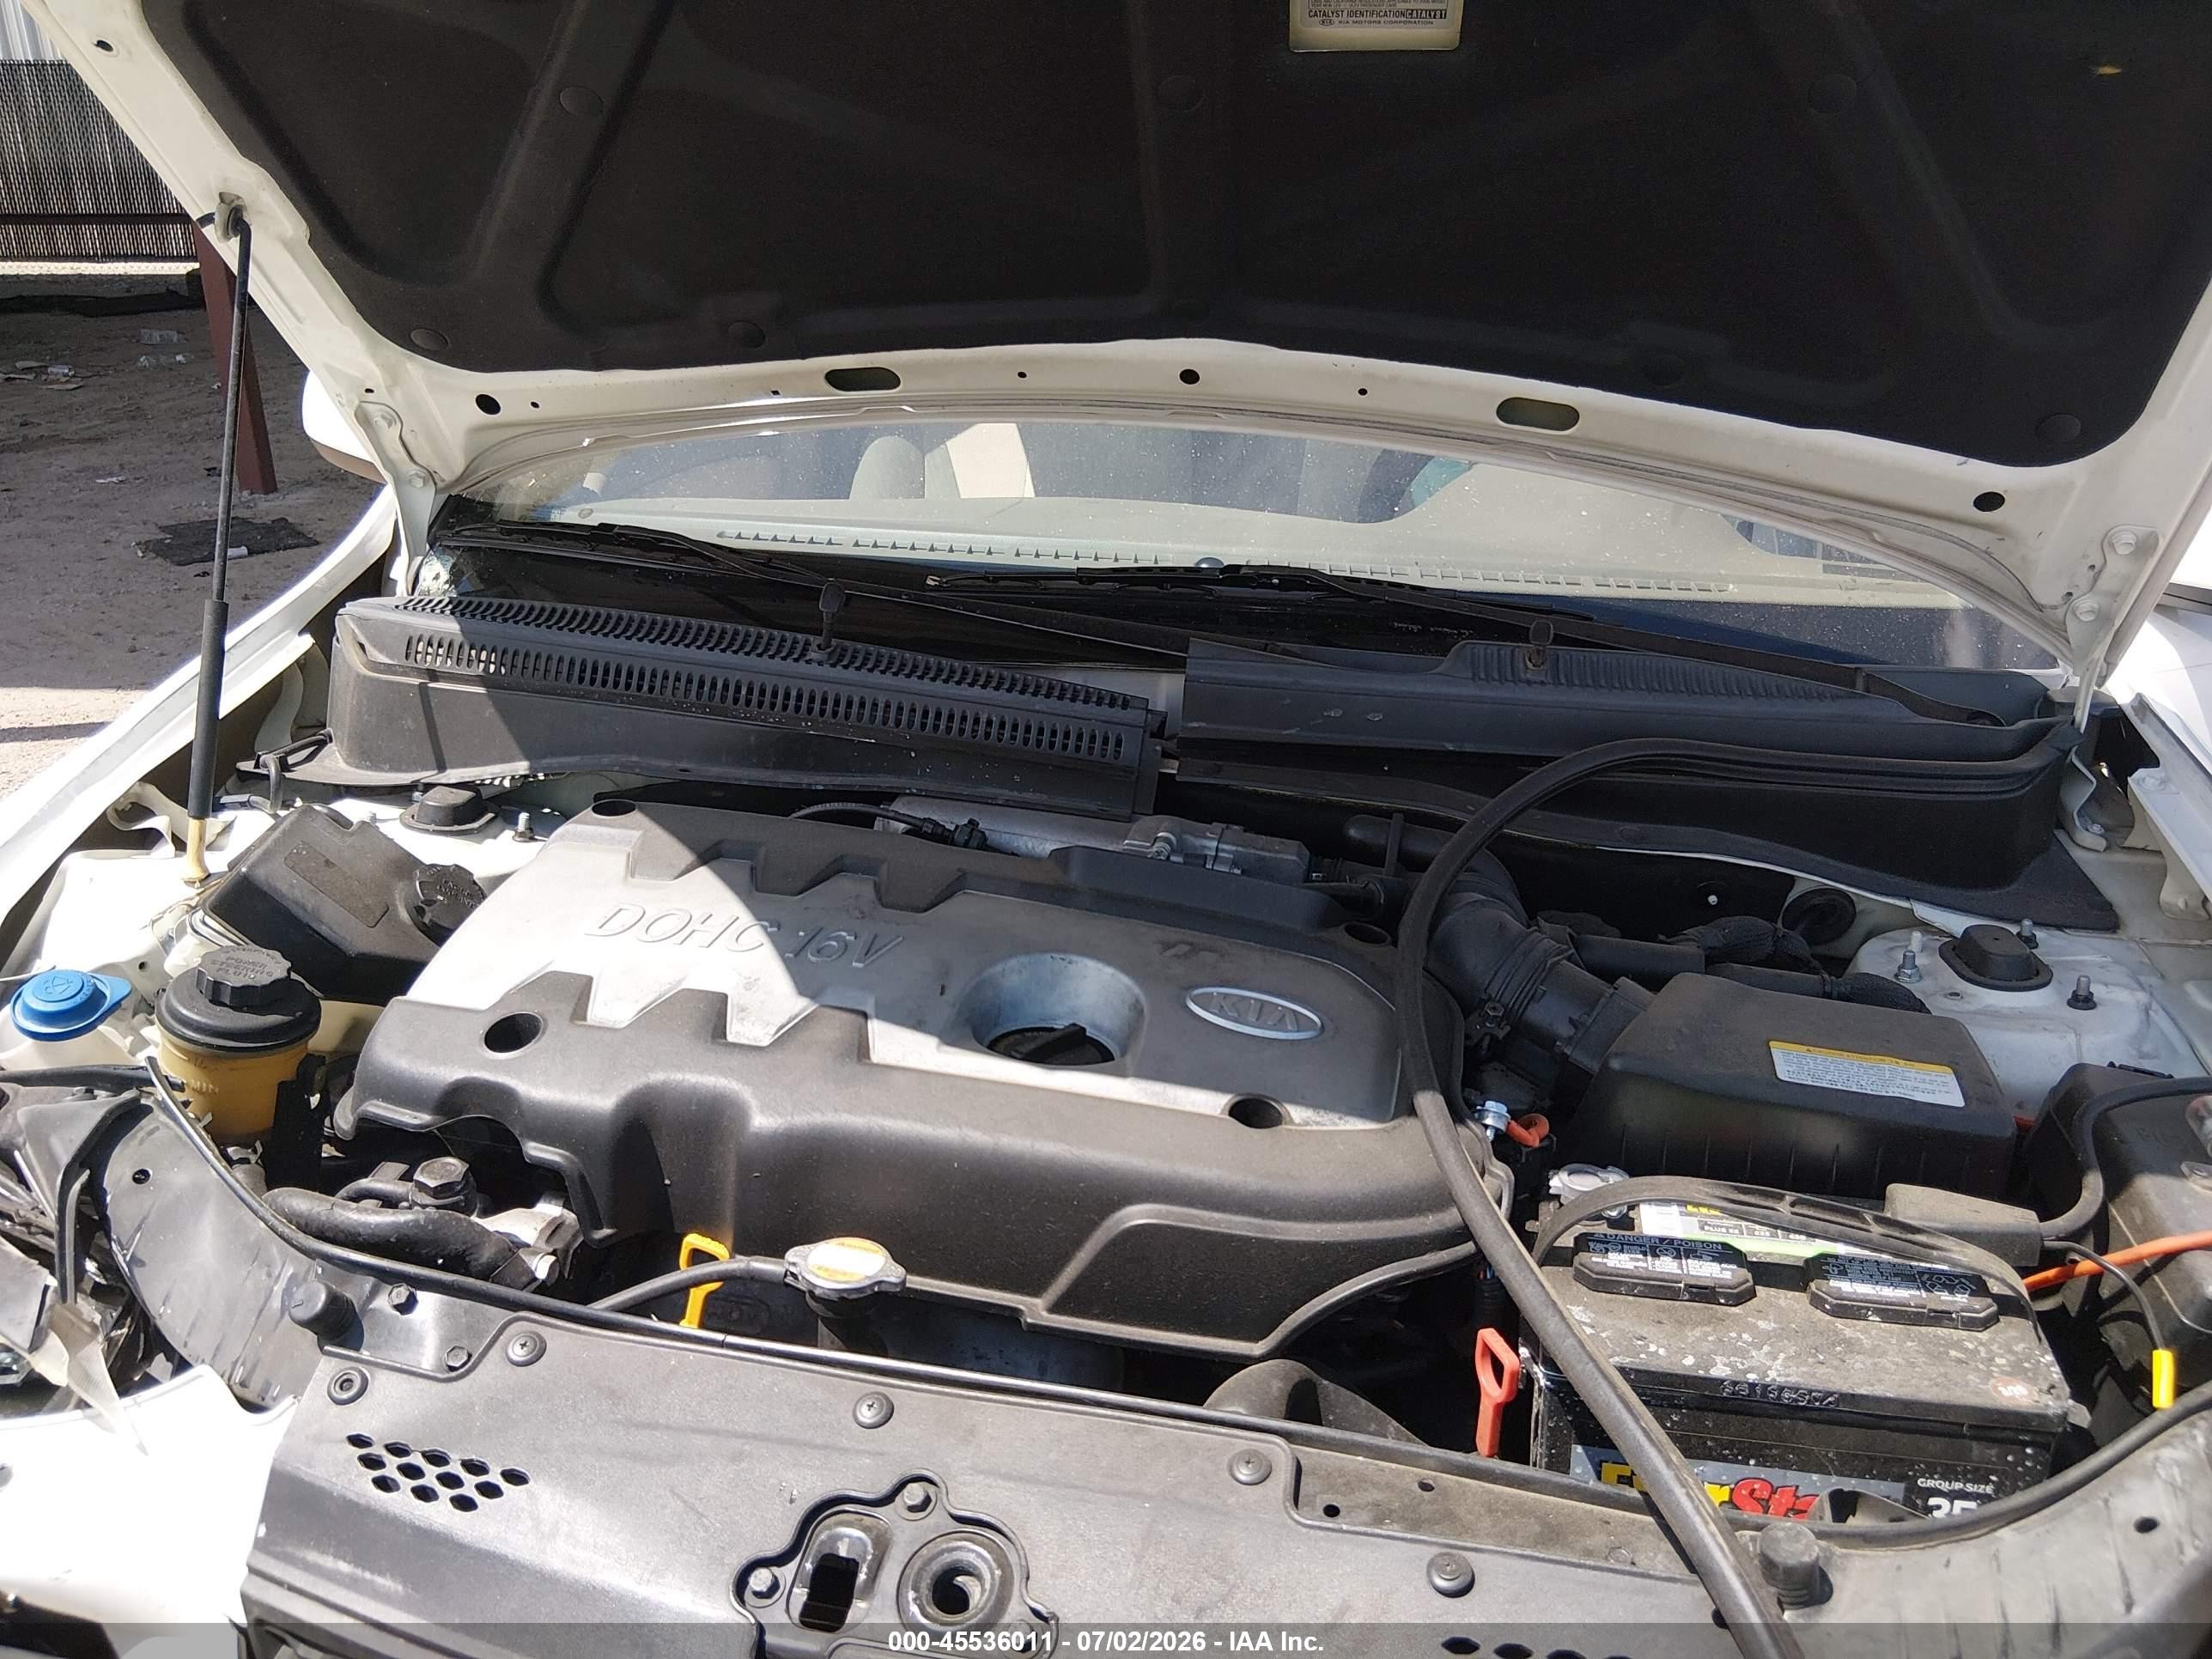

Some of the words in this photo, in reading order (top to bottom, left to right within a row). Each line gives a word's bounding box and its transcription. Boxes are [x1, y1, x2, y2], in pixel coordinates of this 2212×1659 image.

[1309, 9, 1345, 18] CATALYST
[1347, 9, 1406, 18] IDENTIFICATION
[1407, 9, 1446, 19] CATALYST
[585, 902, 780, 952] DOHC
[1208, 993, 1298, 1032] KIA
[1607, 1233, 1659, 1244] DANGER
[1674, 1239, 1723, 1249] POISON
[1917, 1478, 1964, 1492] GROUP
[1964, 1482, 1995, 1493] SIZE
